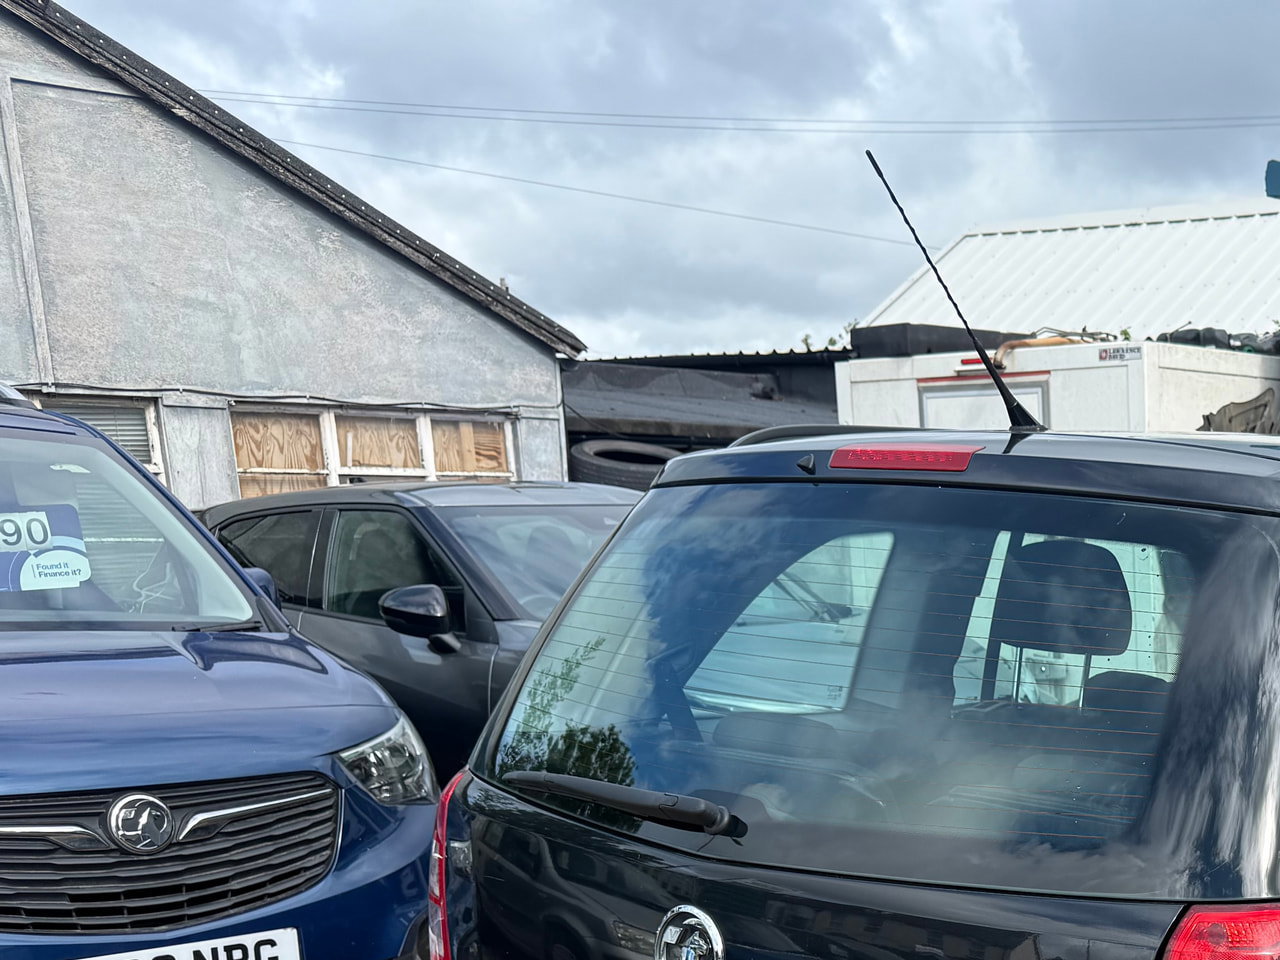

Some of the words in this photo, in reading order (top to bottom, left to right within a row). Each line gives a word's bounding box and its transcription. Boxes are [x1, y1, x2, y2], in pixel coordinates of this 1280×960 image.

[0, 517, 49, 546] 90
[36, 562, 62, 571] Found
[38, 570, 70, 578] Finance
[71, 568, 82, 576] it?
